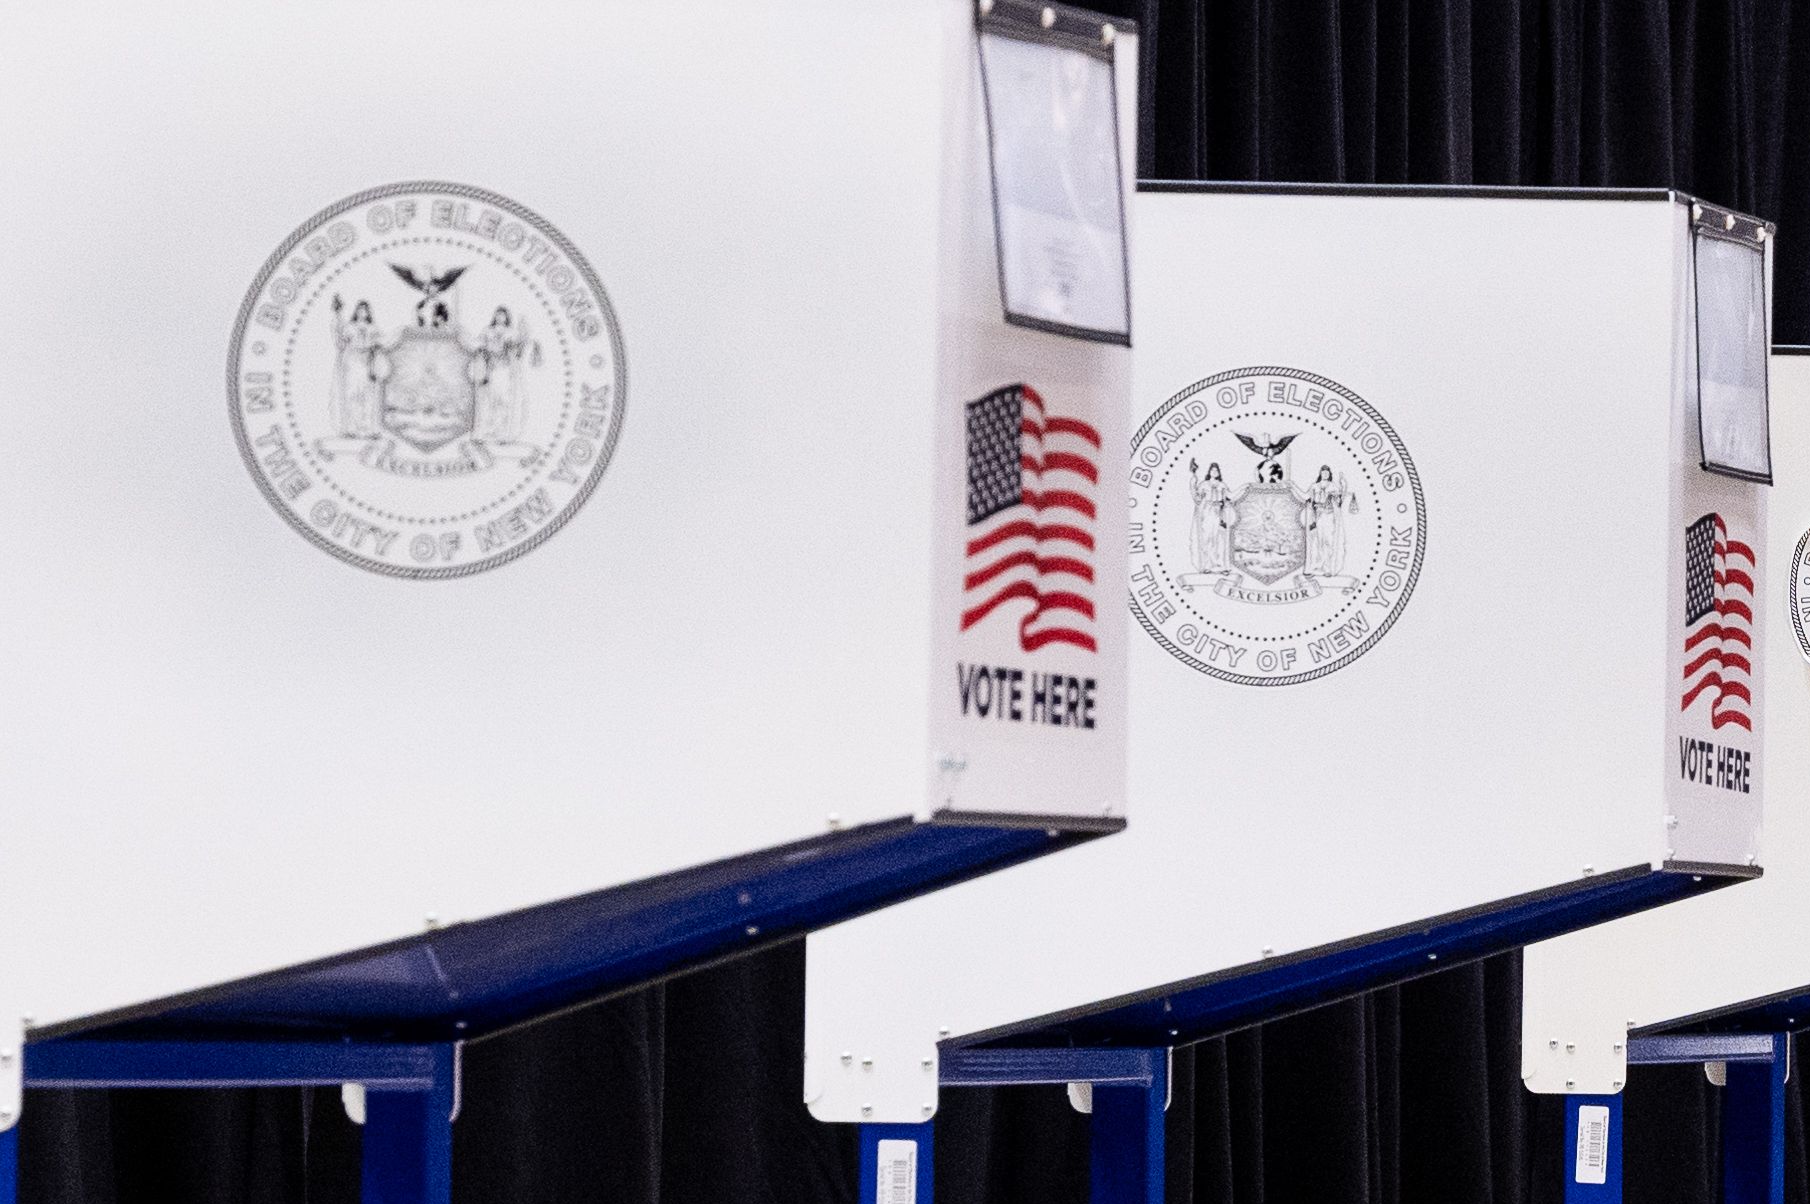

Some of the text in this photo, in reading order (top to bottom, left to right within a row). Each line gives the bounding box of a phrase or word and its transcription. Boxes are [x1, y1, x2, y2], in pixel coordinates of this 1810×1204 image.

[257, 200, 601, 341] BOARD OF ELECTIONS
[245, 372, 610, 562] IN THE CITY OF NEW YORK
[1131, 381, 1404, 492] BOARD OF ELECTIONS
[1131, 565, 1176, 624] THE
[1177, 624, 1248, 668] CITY
[1257, 649, 1297, 672] OF
[1308, 611, 1371, 663] NEW
[1366, 526, 1413, 609] YORK
[1228, 587, 1310, 601] EXCELSIOR
[957, 661, 1096, 729] VOTE HERE
[1680, 736, 1750, 793] VOTE HERE
